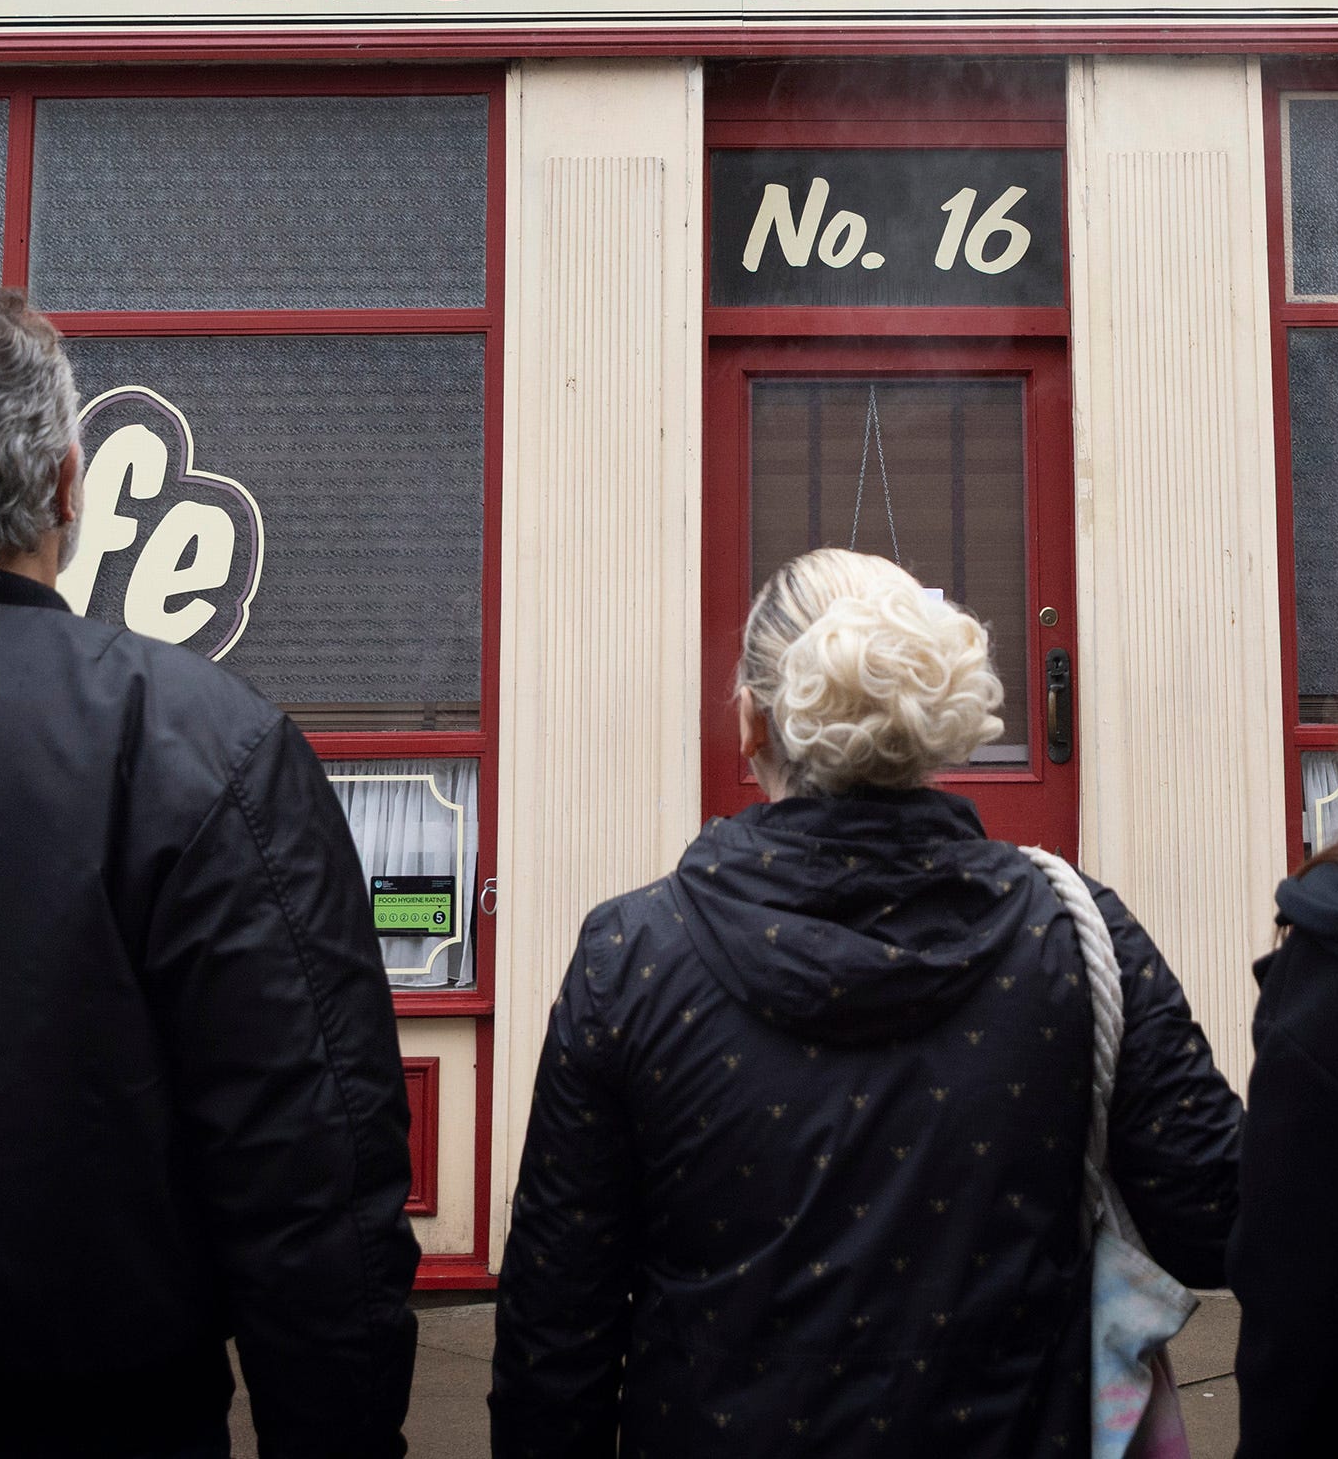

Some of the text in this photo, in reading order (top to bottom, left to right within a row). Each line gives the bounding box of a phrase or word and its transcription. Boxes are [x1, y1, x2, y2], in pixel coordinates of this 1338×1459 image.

[741, 176, 1032, 275] No. 16
[435, 911, 444, 924] 5
